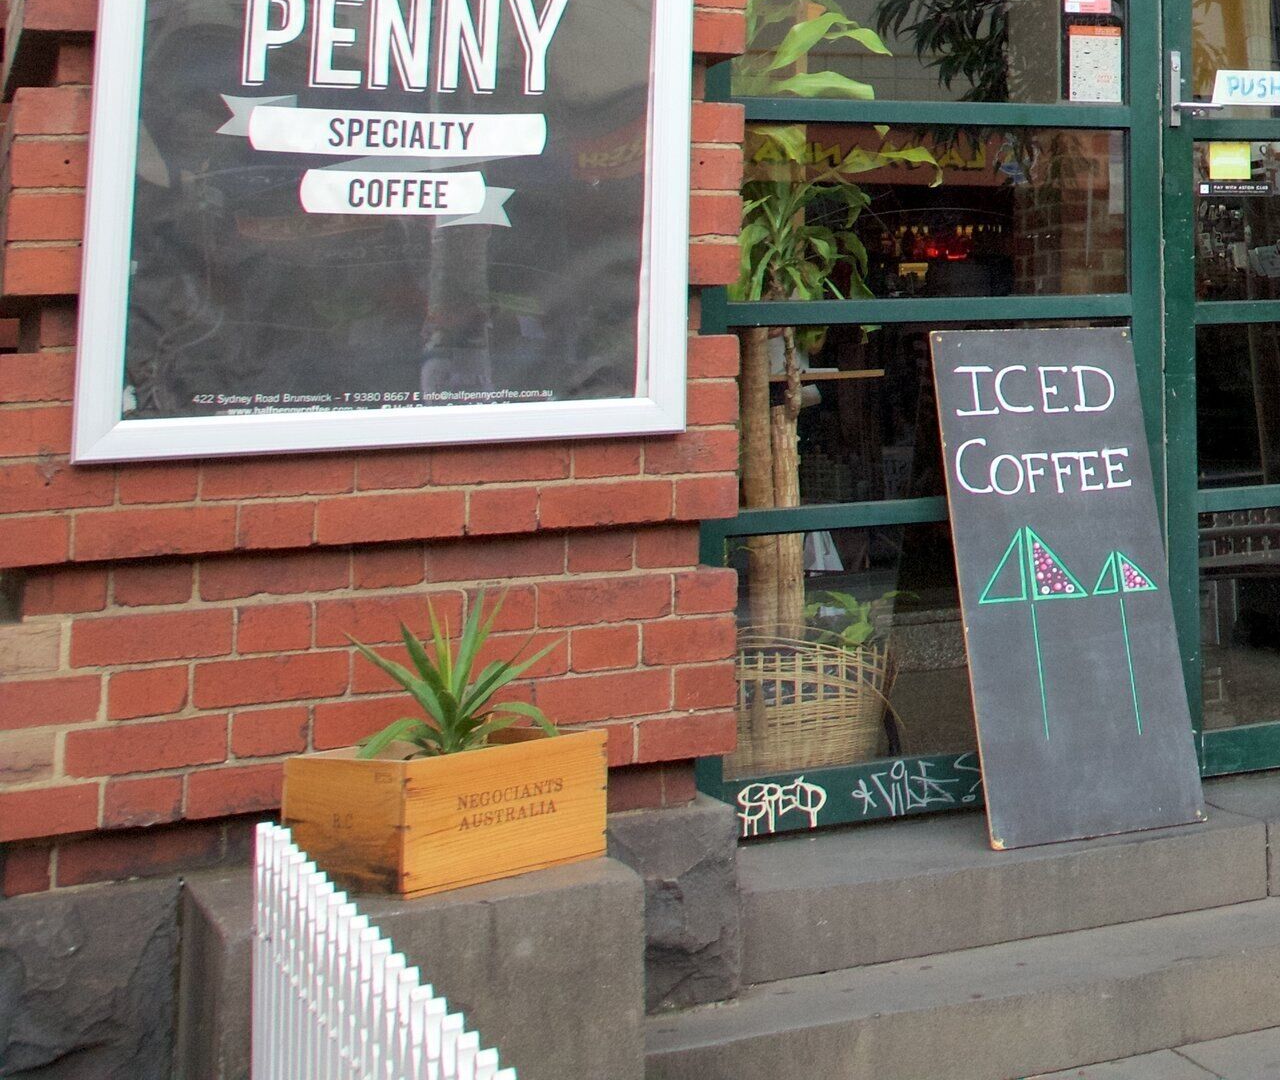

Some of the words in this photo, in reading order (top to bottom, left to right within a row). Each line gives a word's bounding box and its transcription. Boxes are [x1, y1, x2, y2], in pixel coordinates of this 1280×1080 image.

[328, 117, 474, 150] SPECIALTY
[349, 178, 449, 209] COFFEE
[192, 394, 214, 404] 422
[217, 394, 252, 405] Sydney
[255, 394, 280, 403] Road
[283, 393, 332, 403] Brunswick
[344, 393, 350, 402] T
[353, 392, 381, 402] 9380
[383, 392, 409, 401] 8667
[413, 392, 420, 401] E
[423, 389, 553, 401] info@halfpennycoffee.com.au
[953, 364, 1116, 418] ICED
[954, 437, 1132, 497] COFFEE
[456, 778, 564, 811] NEGOCIANTS
[458, 799, 557, 831] AUSTRALIA
